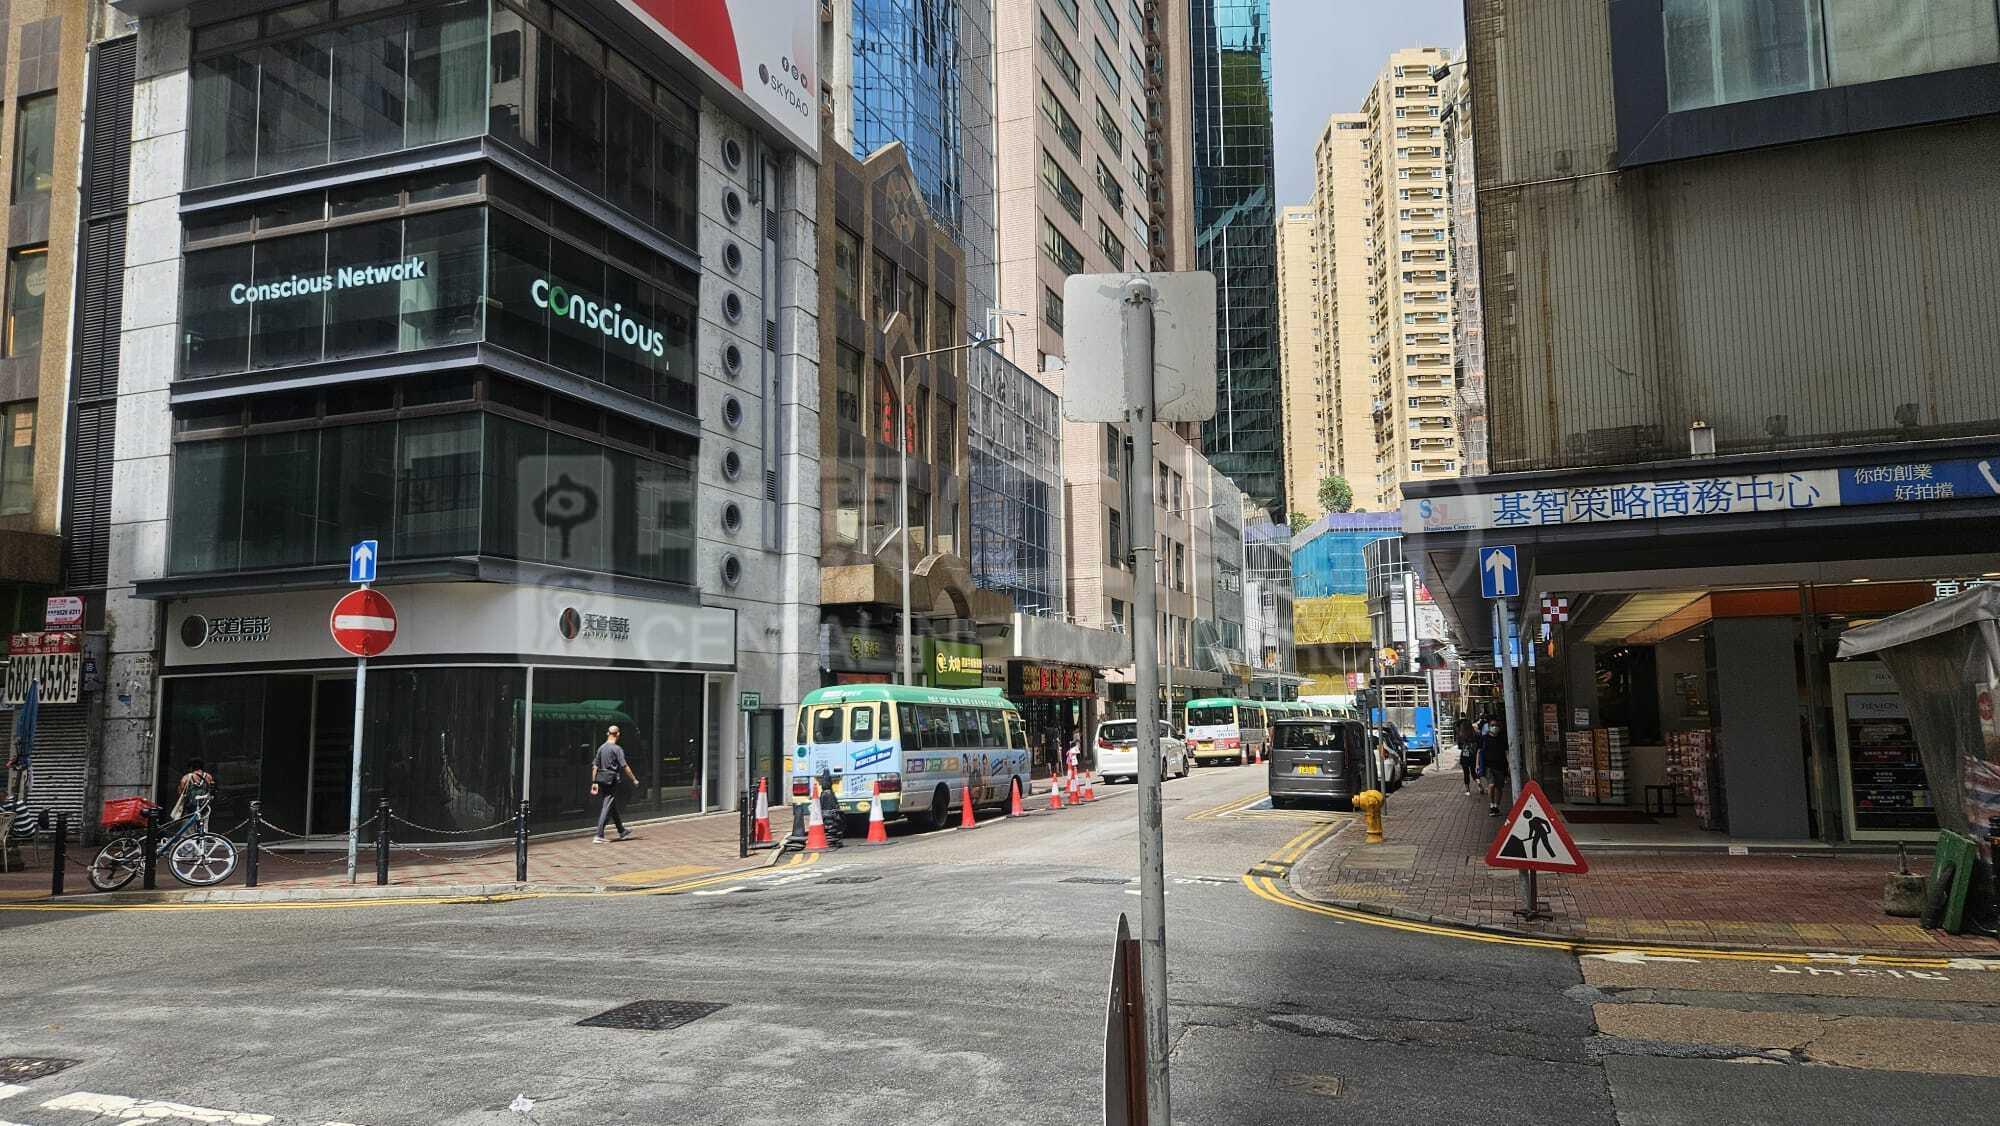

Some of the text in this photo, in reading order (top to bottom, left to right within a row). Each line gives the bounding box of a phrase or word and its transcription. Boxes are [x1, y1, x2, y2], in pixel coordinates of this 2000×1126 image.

[771, 74, 810, 118] SKYDAO
[230, 256, 426, 305] Conscious Network
[1853, 462, 1935, 486] 你的創業
[1493, 474, 1821, 527] 基智策略商務中心
[209, 615, 272, 636] 天道信託
[583, 613, 631, 633] 天道信託
[39, 653, 70, 702] 9558
